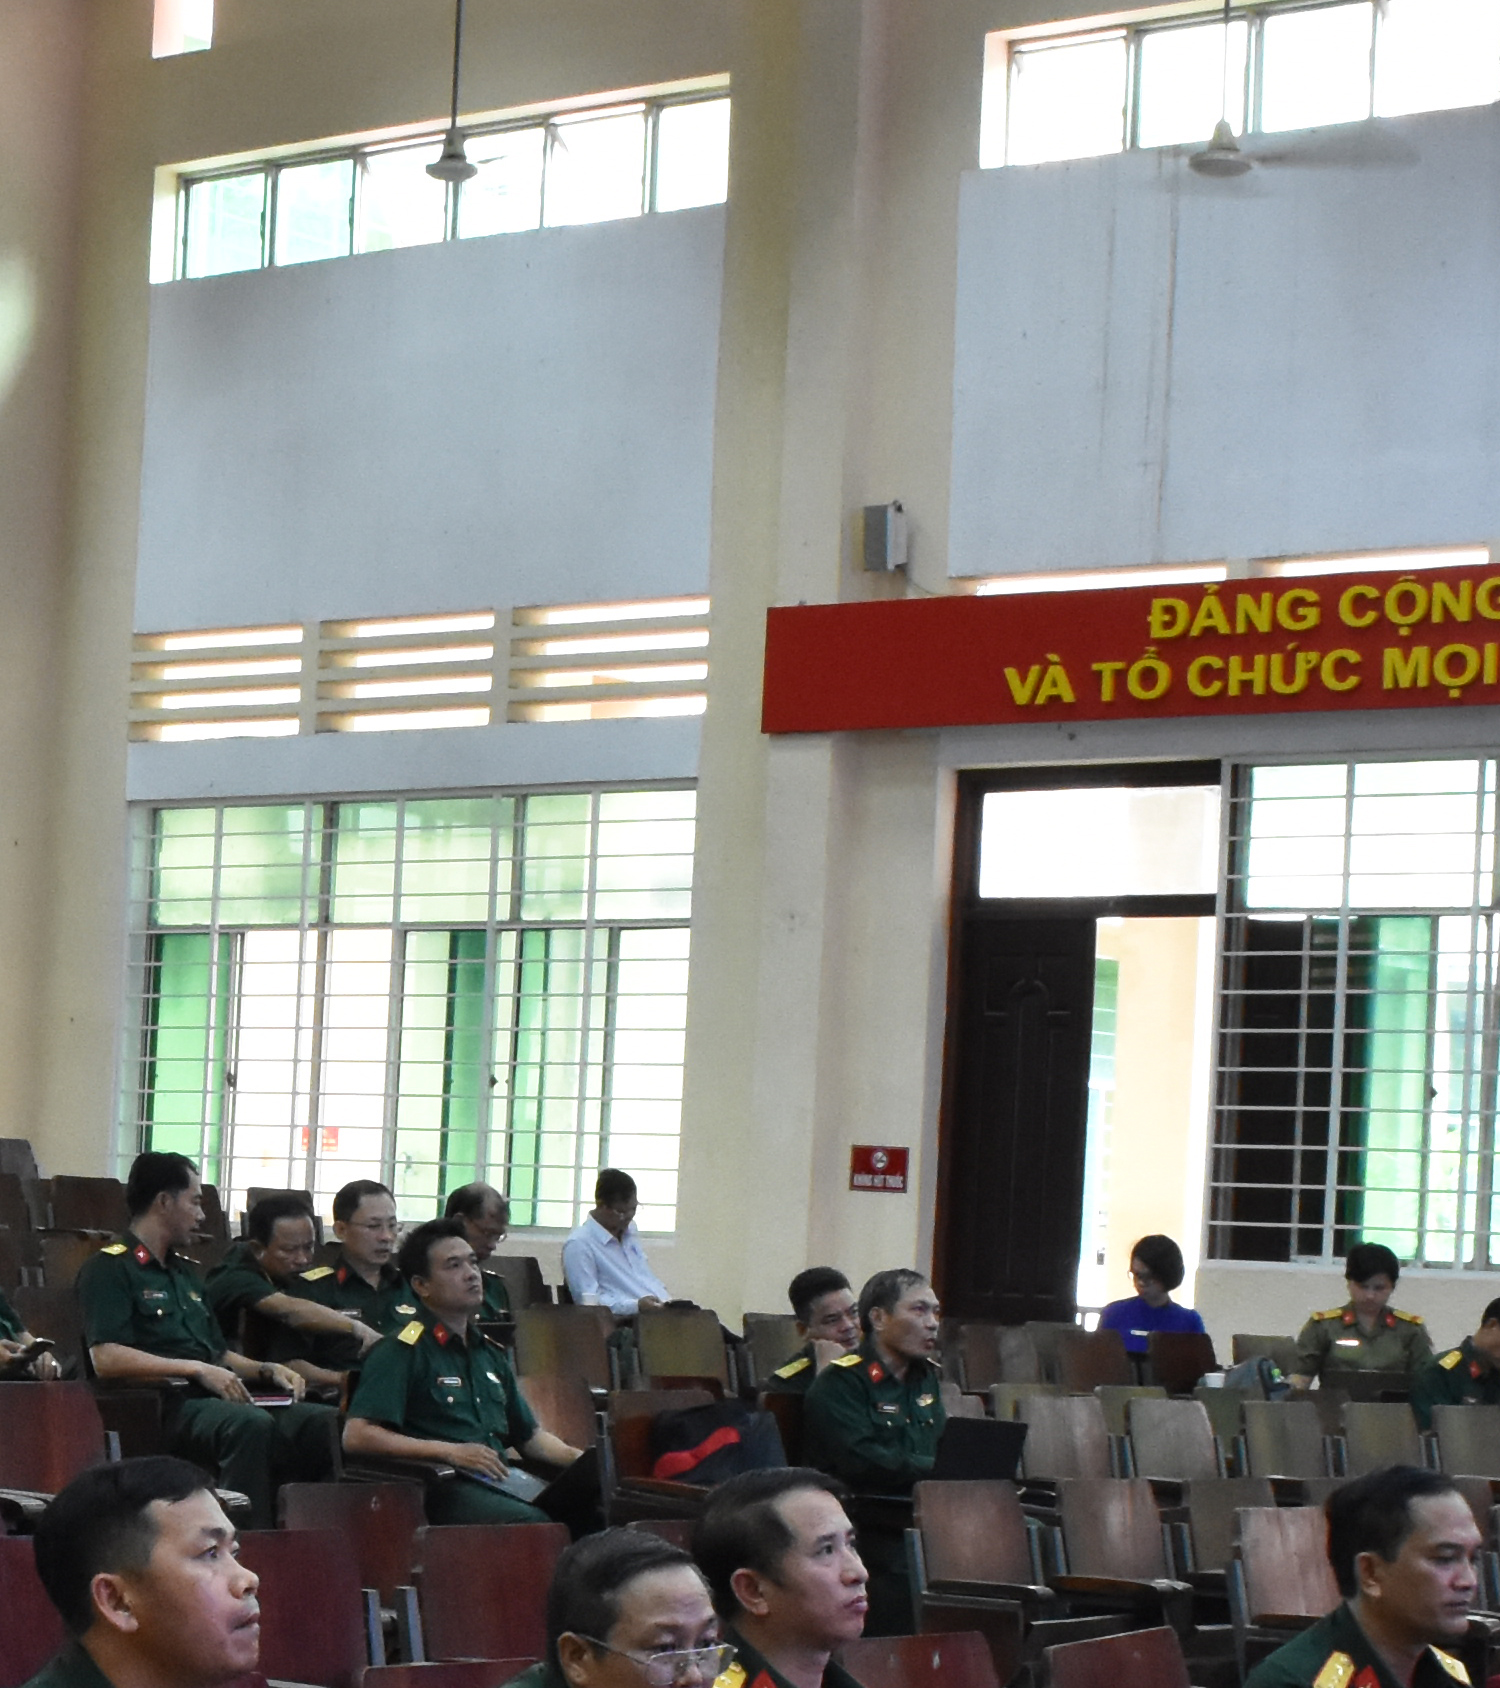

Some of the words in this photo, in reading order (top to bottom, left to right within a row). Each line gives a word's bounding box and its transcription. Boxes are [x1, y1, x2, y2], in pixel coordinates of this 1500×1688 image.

[1147, 584, 1322, 639] ĐẢNG
[1003, 652, 1077, 706] VÀ
[1091, 646, 1172, 701] TỔ
[1186, 642, 1362, 698] CHỨC
[1382, 642, 1498, 699] MỌI
